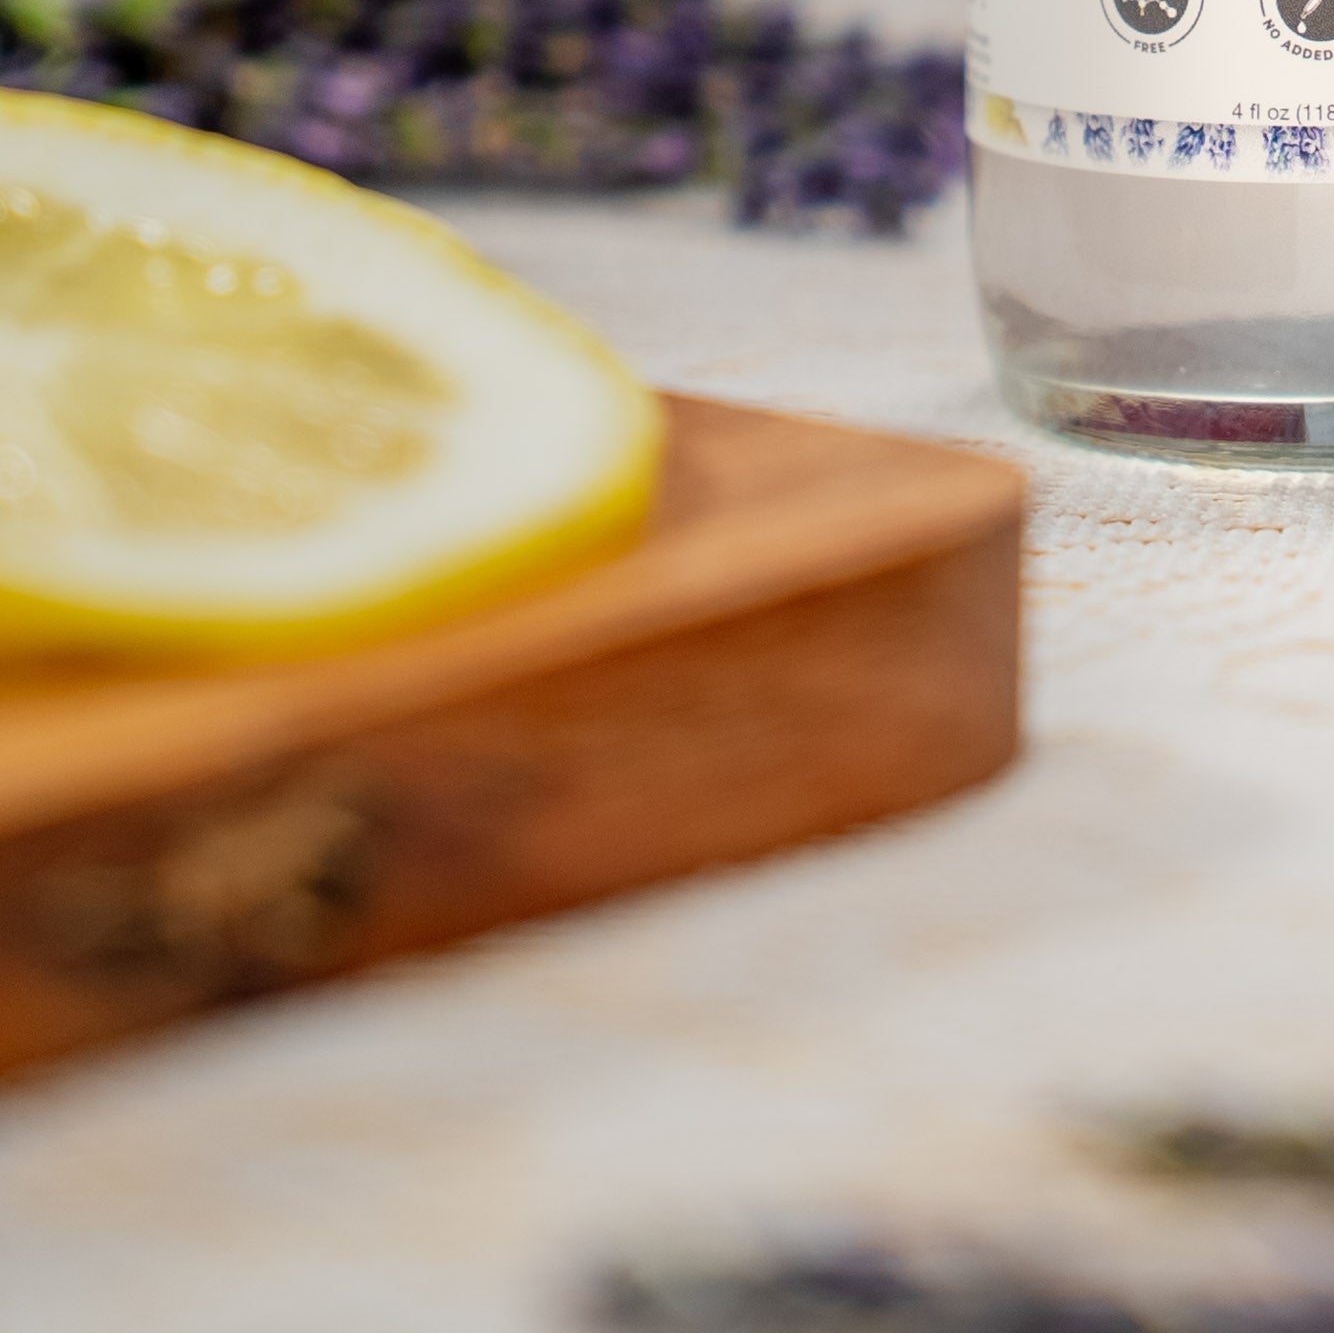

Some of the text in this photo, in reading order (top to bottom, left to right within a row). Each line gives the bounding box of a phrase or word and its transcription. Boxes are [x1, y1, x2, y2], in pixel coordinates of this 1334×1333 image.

[1133, 39, 1167, 54] FREE
[1262, 18, 1281, 39] NO
[1281, 40, 1334, 61] ADDED
[1231, 102, 1243, 120] 4
[1249, 102, 1261, 120] fl
[1267, 107, 1290, 121] oz
